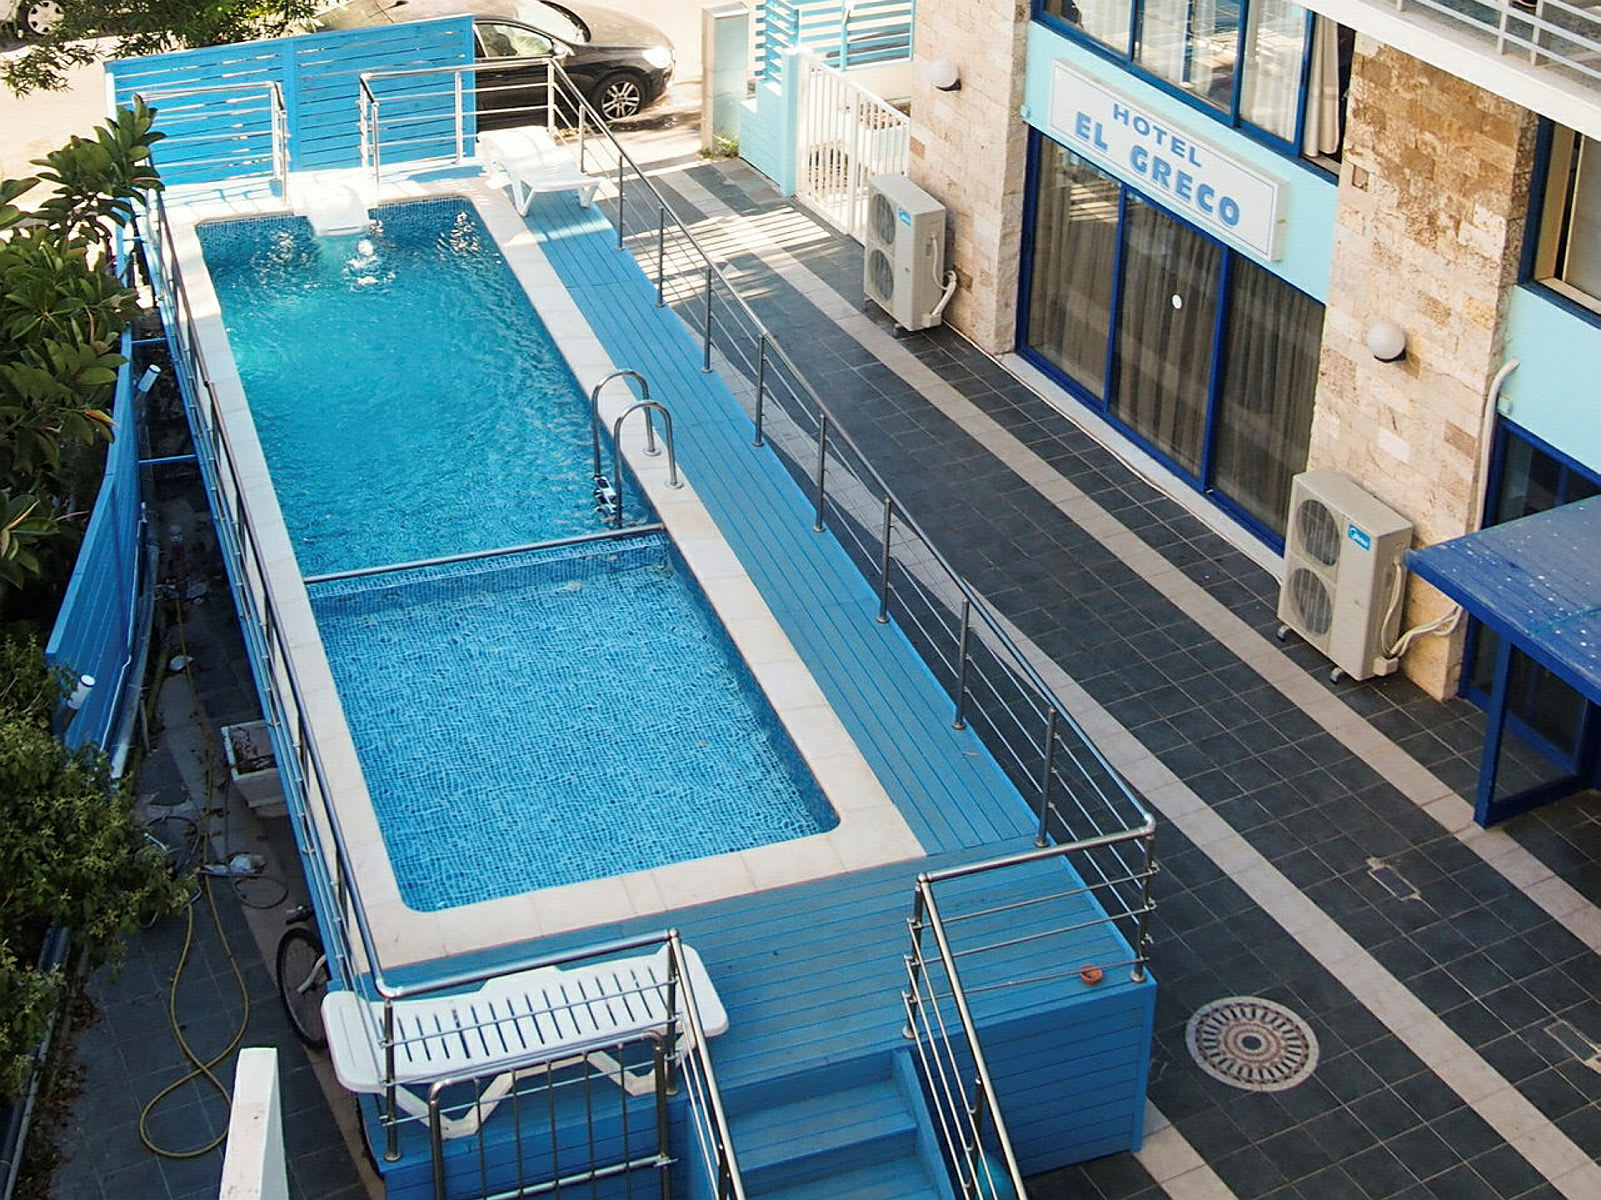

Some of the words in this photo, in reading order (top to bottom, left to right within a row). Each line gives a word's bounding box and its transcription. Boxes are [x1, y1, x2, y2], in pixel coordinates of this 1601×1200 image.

[1075, 111, 1109, 152] EL
[1129, 144, 1241, 228] GRECO
[1113, 103, 1203, 168] HOTEL
